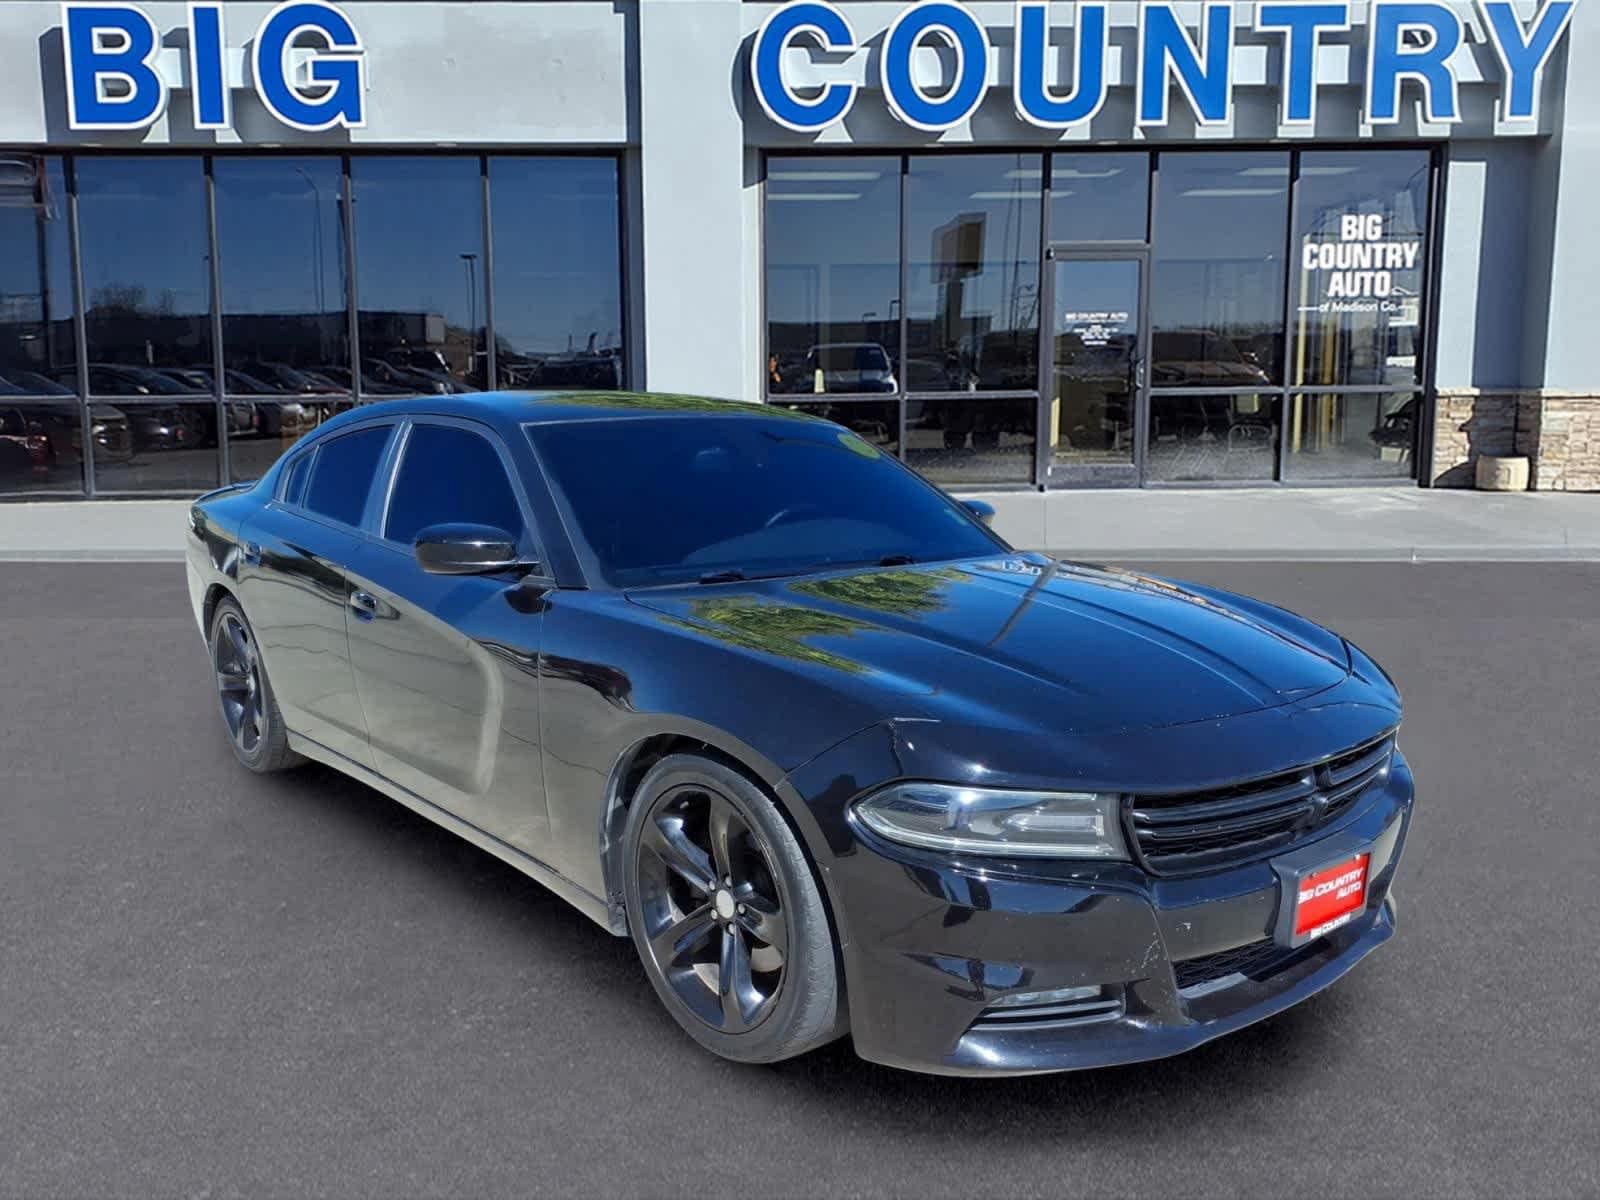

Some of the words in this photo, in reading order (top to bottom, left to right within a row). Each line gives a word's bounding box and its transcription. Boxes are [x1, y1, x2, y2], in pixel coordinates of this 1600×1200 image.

[61, 1, 367, 131] BIG
[751, 0, 1576, 132] COUNTRY
[1341, 214, 1383, 240] BIG
[1303, 242, 1419, 270] COUNTRY
[1328, 271, 1391, 297] AUTO
[1331, 301, 1378, 312] Madison
[1315, 867, 1364, 897] COUNTRY
[1336, 881, 1362, 900] AUTO
